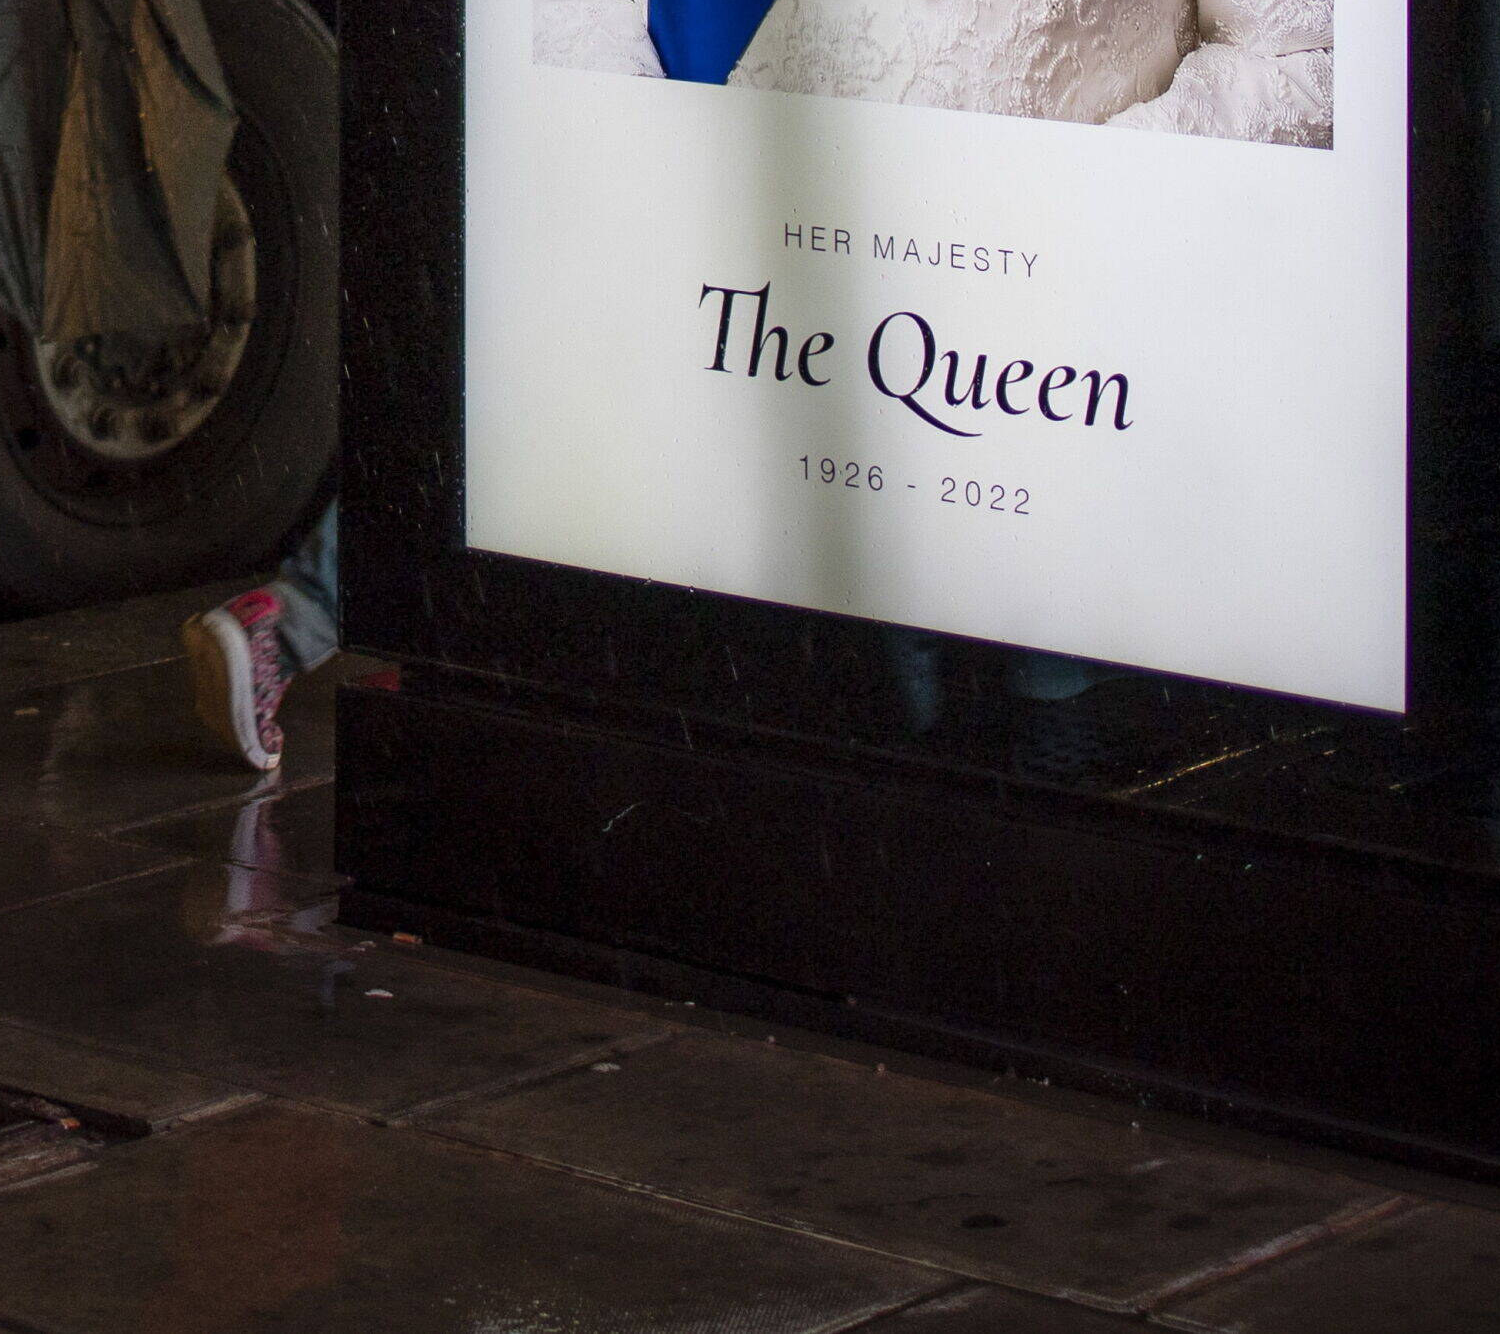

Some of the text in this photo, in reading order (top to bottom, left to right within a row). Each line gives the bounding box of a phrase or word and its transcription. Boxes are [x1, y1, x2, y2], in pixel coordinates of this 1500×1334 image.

[783, 222, 1039, 279] HER MAJESTY
[697, 280, 1135, 438] The Queen
[798, 453, 885, 492] 1926
[940, 477, 1032, 517] 2022
